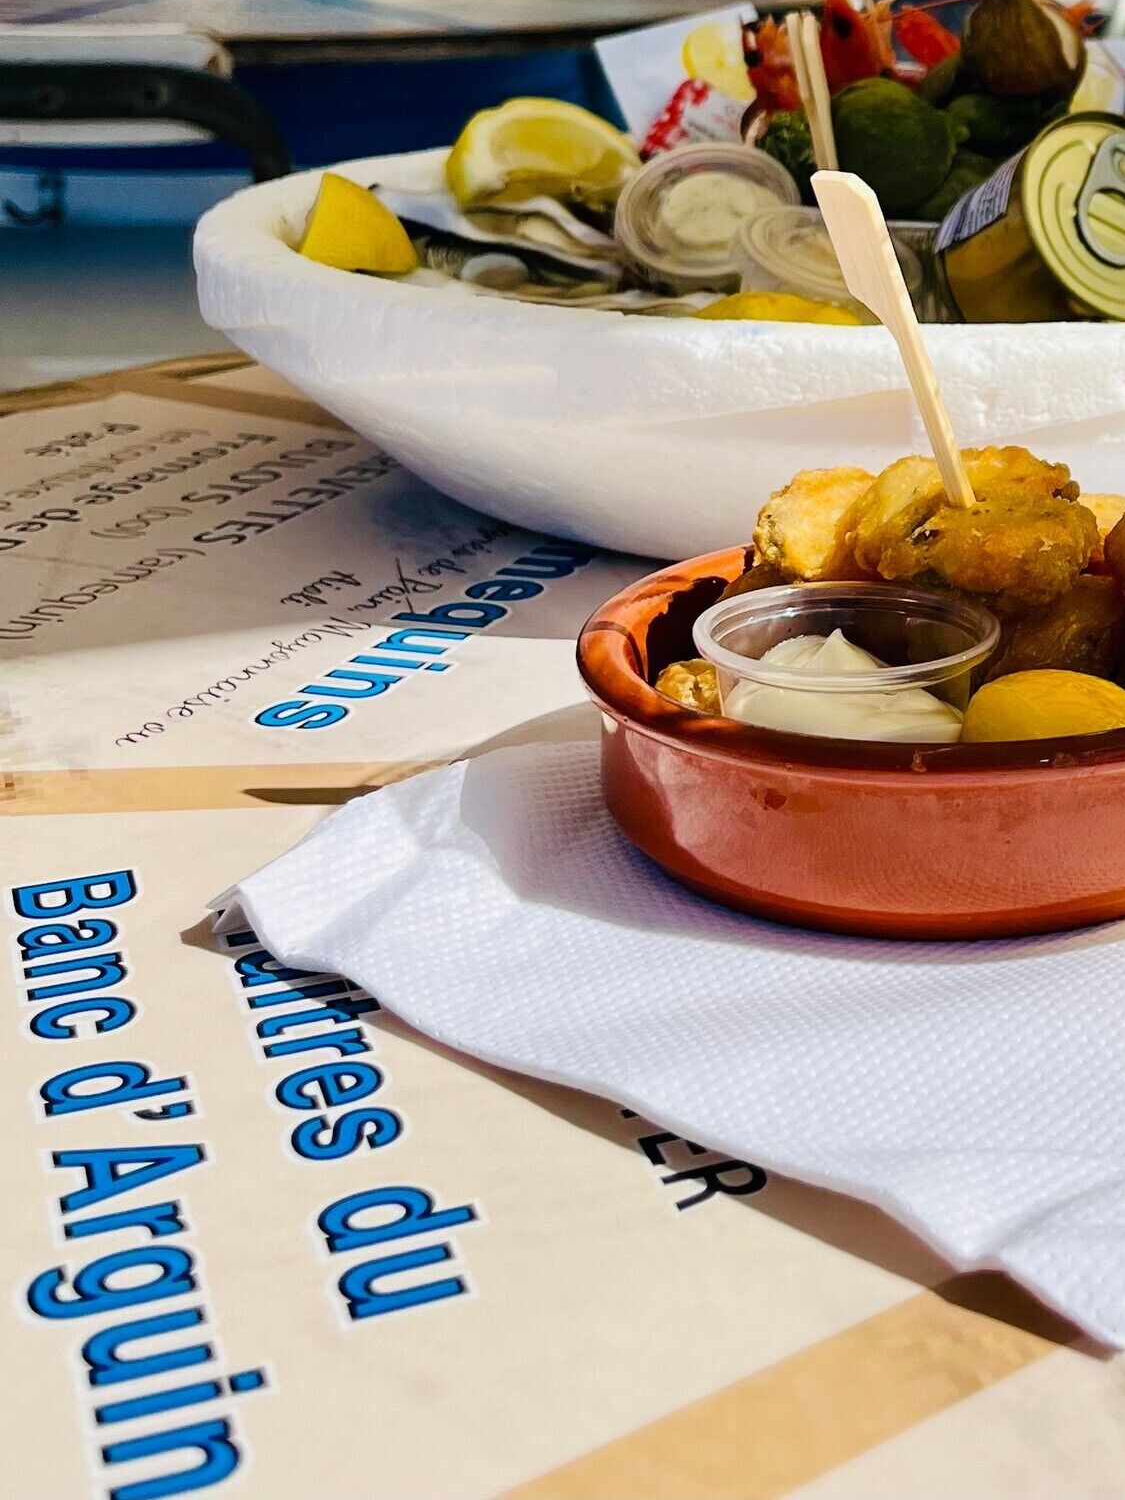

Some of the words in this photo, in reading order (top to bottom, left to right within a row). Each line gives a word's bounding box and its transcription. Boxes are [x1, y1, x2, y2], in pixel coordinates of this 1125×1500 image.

[4, 508, 82, 535] de
[418, 558, 467, 577] de
[0, 548, 207, 640] (ramequin)
[167, 615, 372, 719] Mayonnaise
[115, 722, 166, 748] ou
[12, 869, 138, 1040] Banc
[317, 1185, 478, 1321] du
